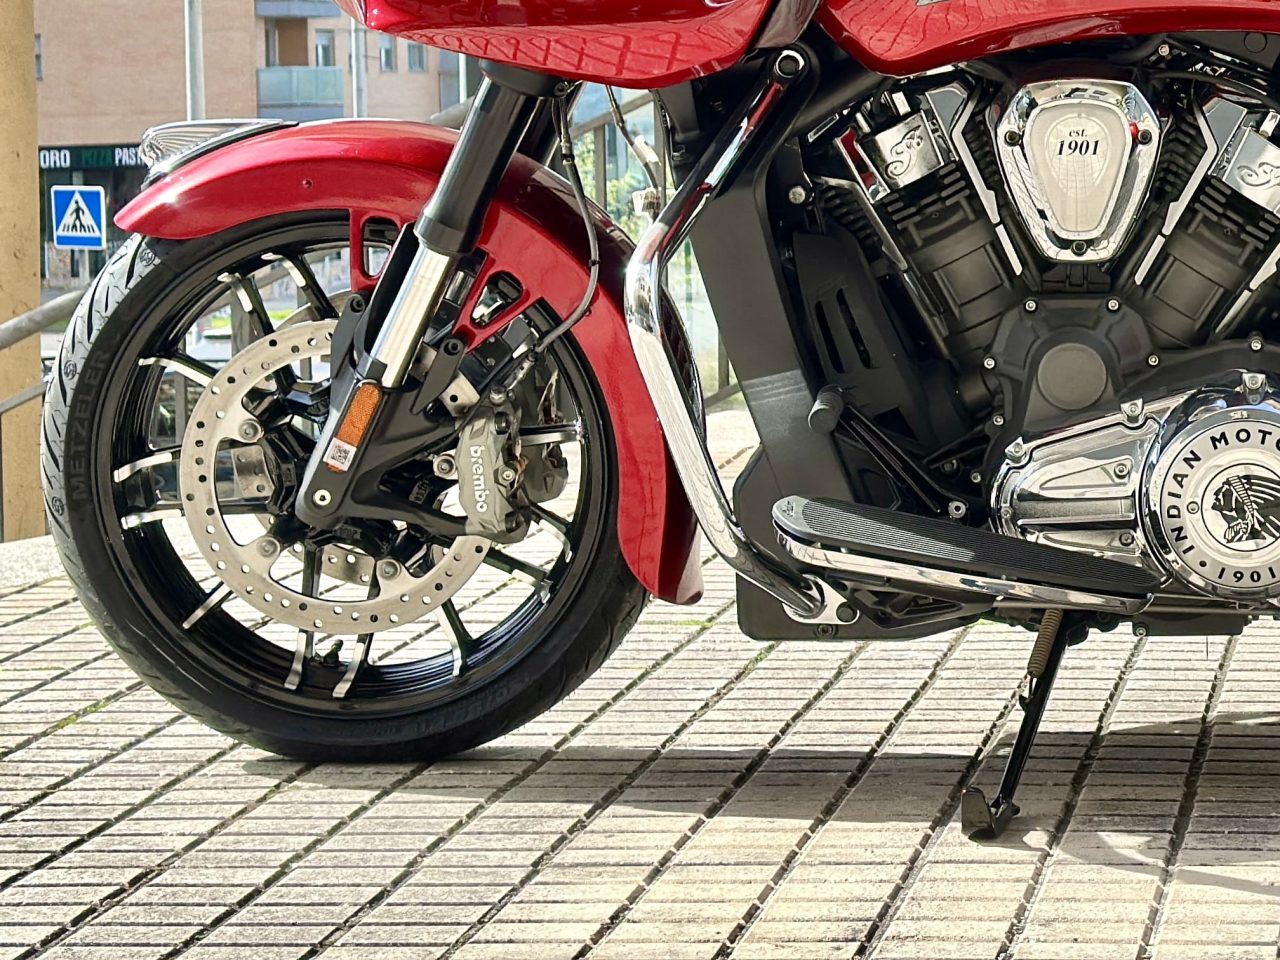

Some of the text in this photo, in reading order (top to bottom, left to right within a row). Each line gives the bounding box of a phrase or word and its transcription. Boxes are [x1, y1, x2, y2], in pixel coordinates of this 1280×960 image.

[1068, 128, 1088, 138] est.
[1056, 139, 1099, 156] 1901
[469, 445, 490, 513] brembo
[1166, 449, 1202, 556] INDIAN
[1217, 566, 1277, 584] 1901
